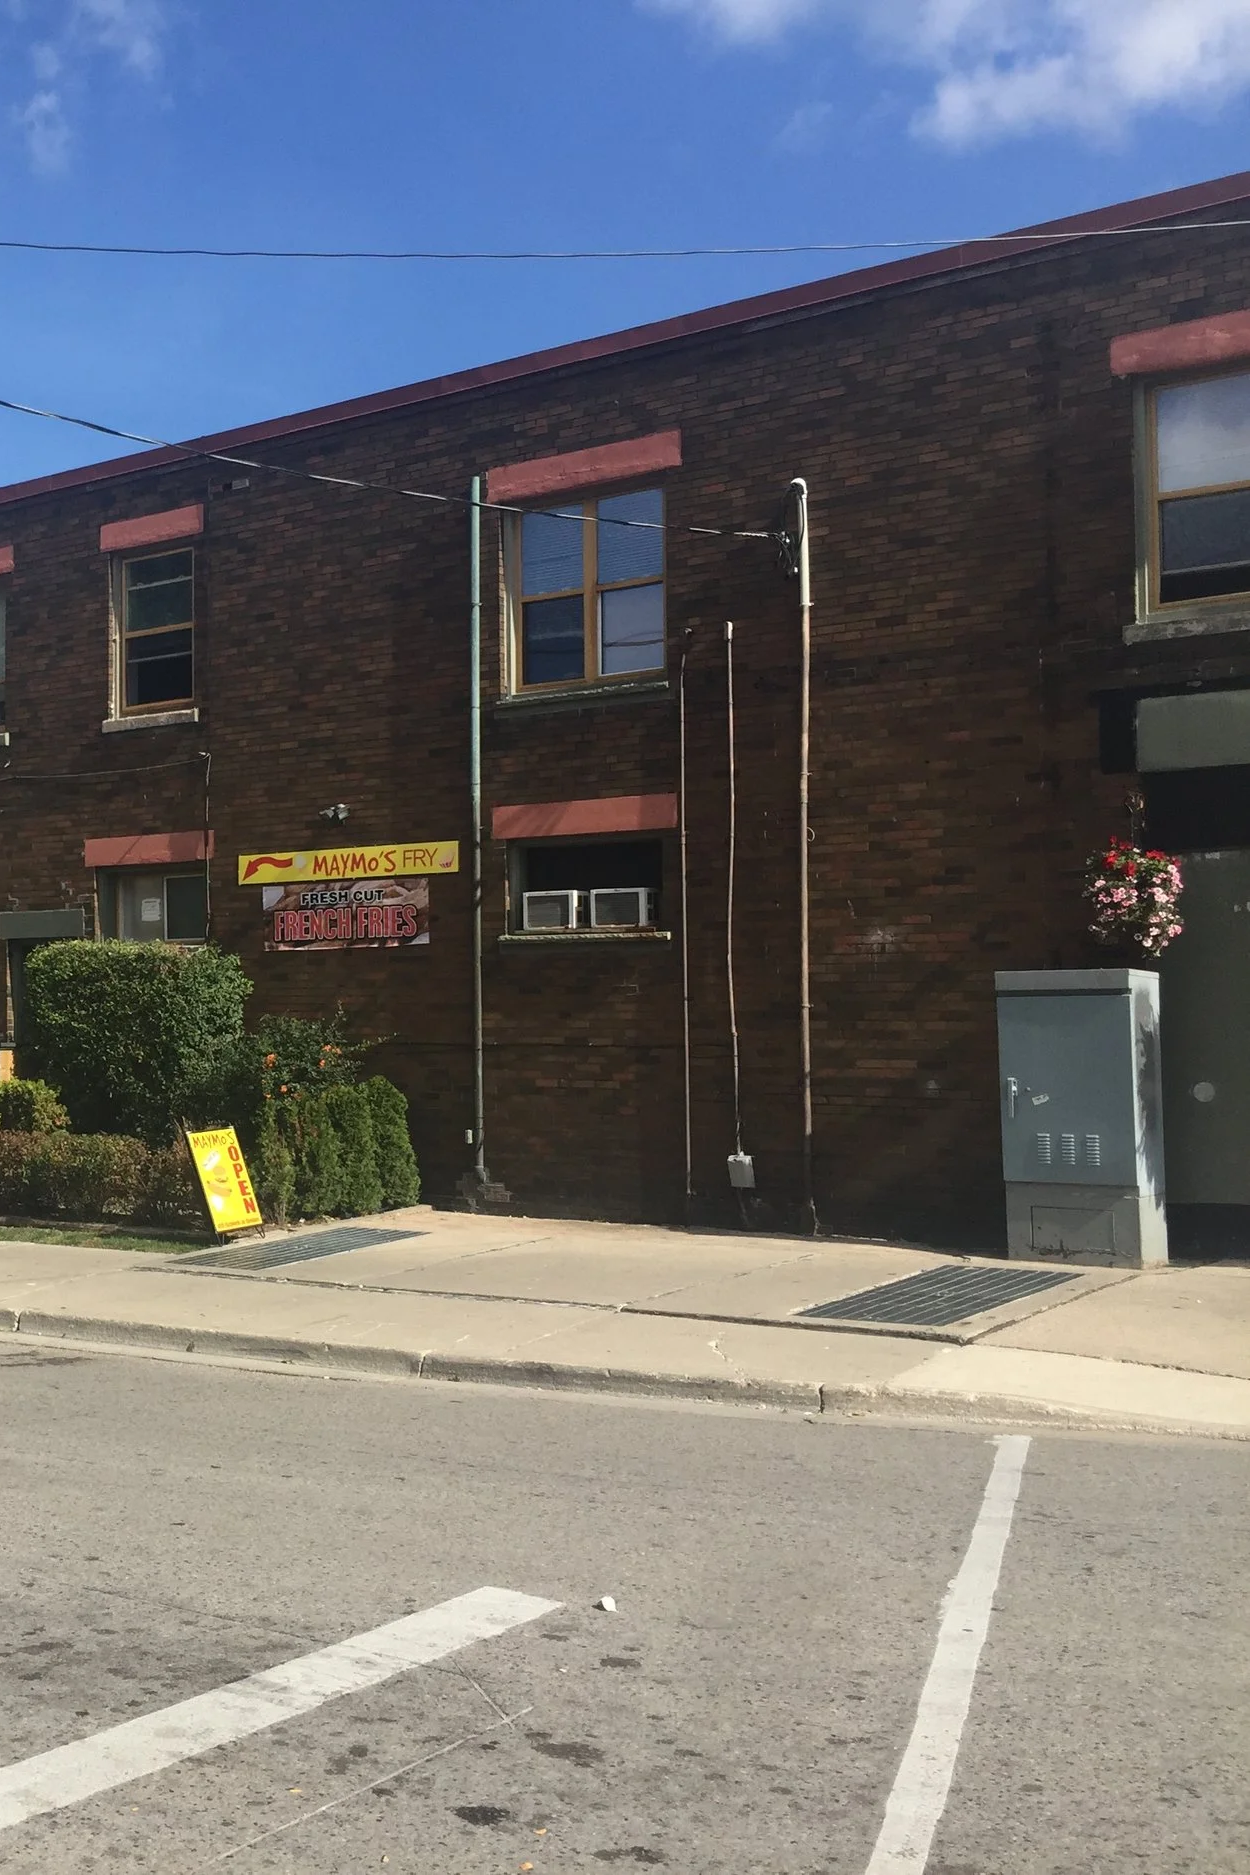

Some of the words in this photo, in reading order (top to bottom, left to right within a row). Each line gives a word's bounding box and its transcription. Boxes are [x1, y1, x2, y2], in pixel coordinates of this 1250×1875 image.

[312, 850, 397, 878] MAYMO'S
[402, 848, 438, 868] FRY
[301, 891, 349, 906] FRESH
[353, 889, 384, 902] CUT
[274, 907, 352, 942] FRENCH
[357, 905, 418, 939] FRIES
[227, 1145, 257, 1214] OPEN
